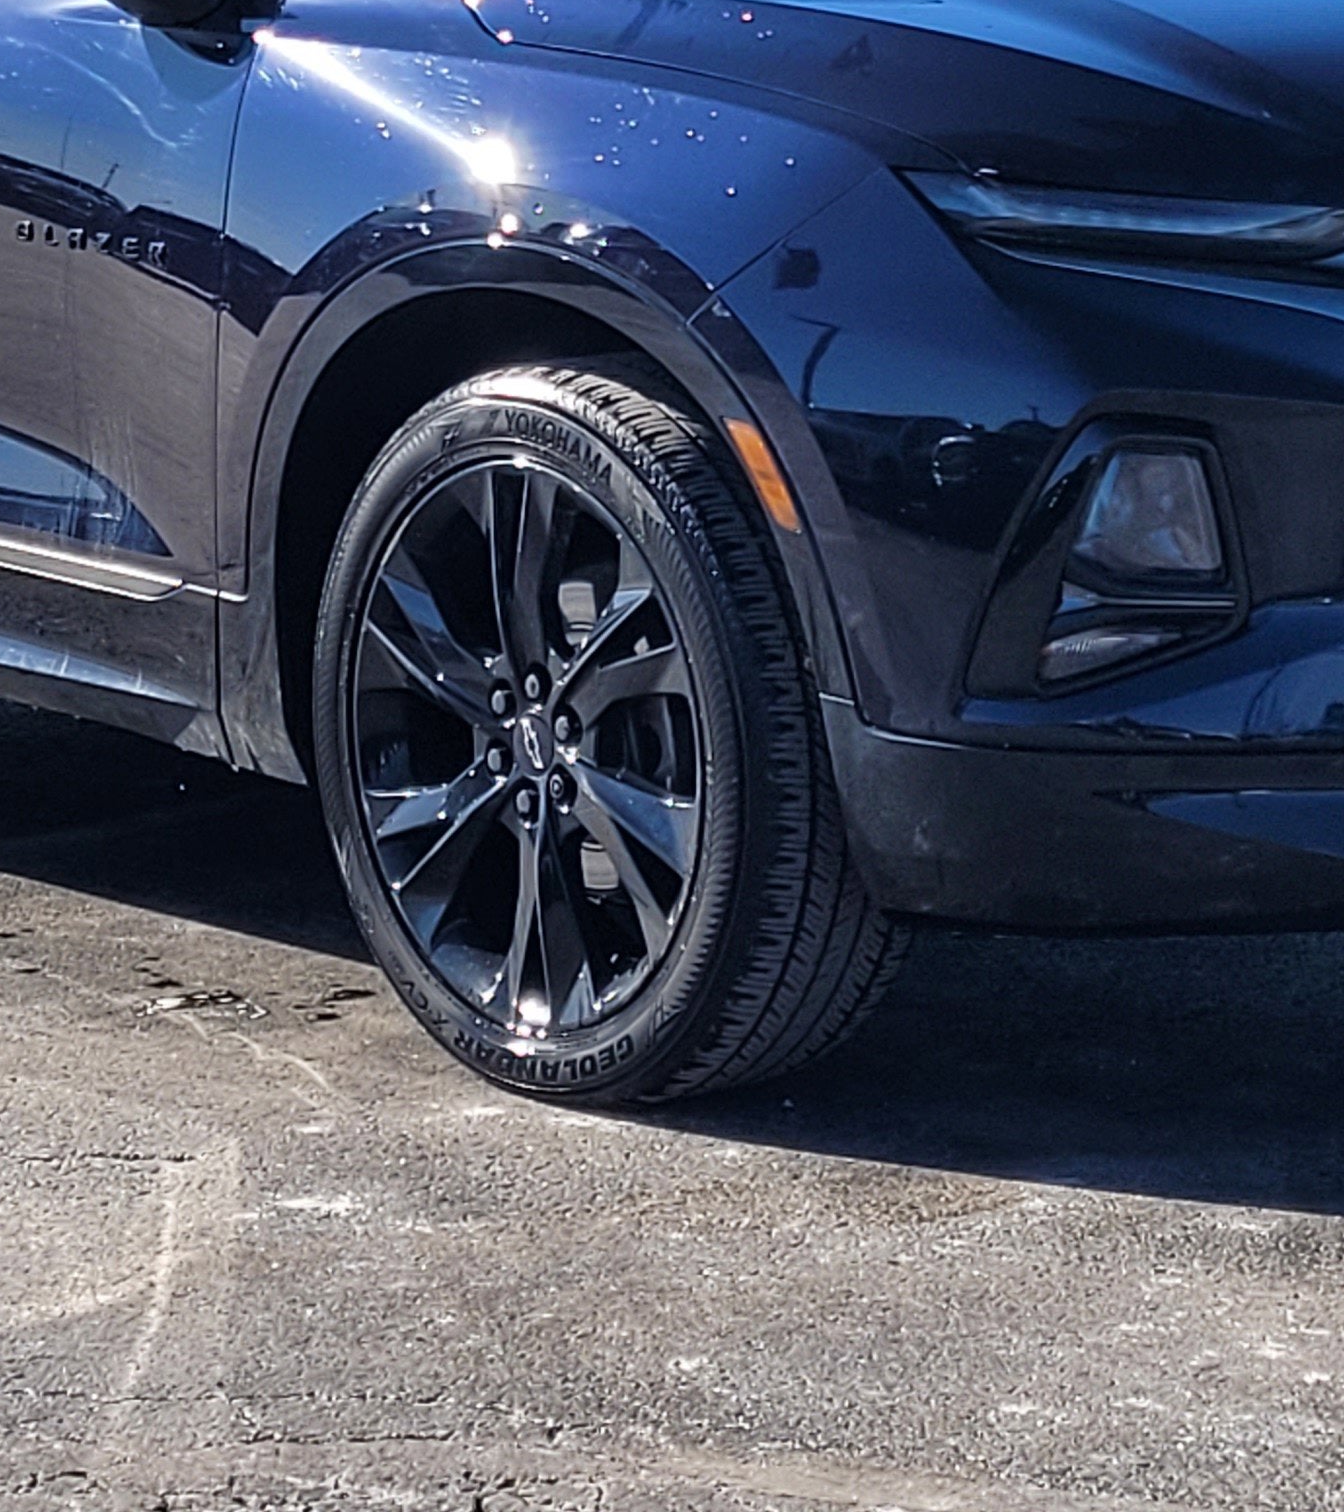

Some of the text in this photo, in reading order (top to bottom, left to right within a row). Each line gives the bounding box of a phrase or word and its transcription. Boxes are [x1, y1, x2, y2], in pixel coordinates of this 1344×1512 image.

[16, 220, 169, 270] BLAZER
[505, 409, 613, 489] YOKOHAMA
[454, 1033, 635, 1082] GEOLANDAR
